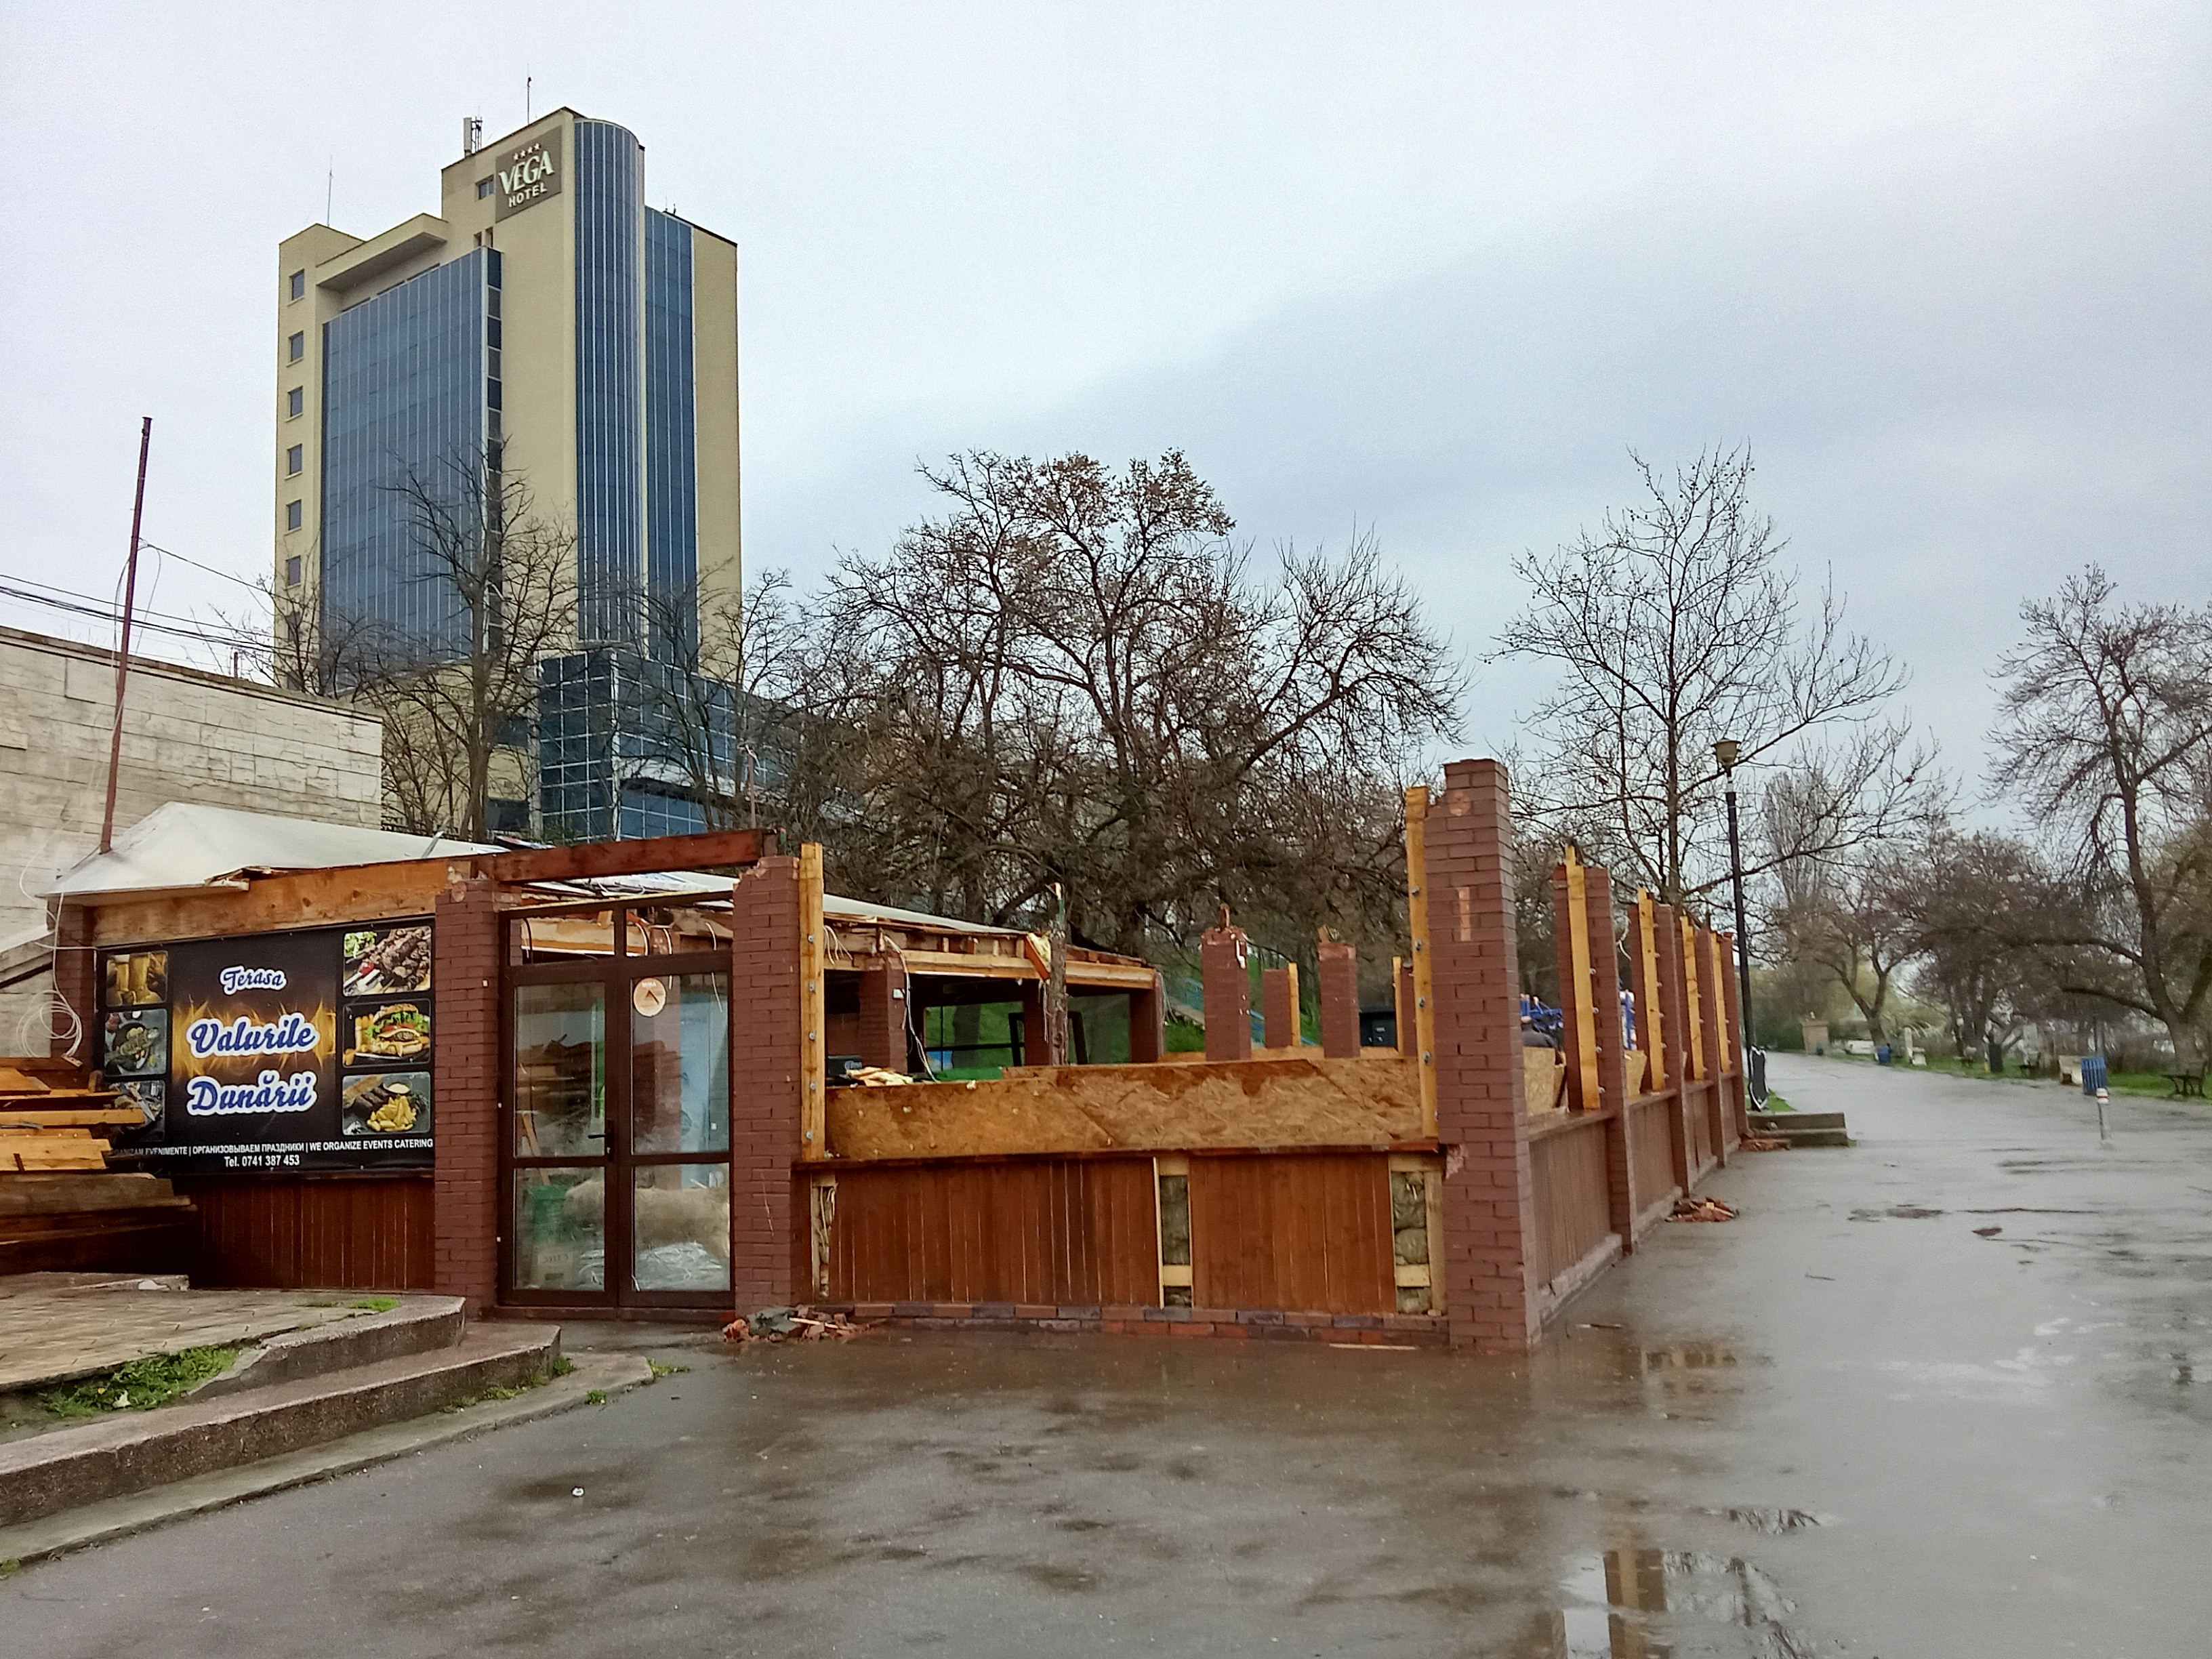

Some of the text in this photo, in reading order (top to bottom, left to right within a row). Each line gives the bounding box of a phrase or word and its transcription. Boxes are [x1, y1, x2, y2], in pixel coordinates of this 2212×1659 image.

[498, 150, 554, 194] VEGA
[508, 182, 548, 207] HOTEL
[222, 967, 285, 993] Terasa
[189, 1016, 317, 1055] Valurile
[190, 1073, 313, 1112] Dunării
[192, 1143, 304, 1154] ОРГАНИЗОВЫВАЕМ ПРАЗДНИКИ
[309, 1139, 433, 1151] WE ORGANIZE EVENTS CATERING
[224, 1154, 300, 1168] Tel. 0741 387 453
